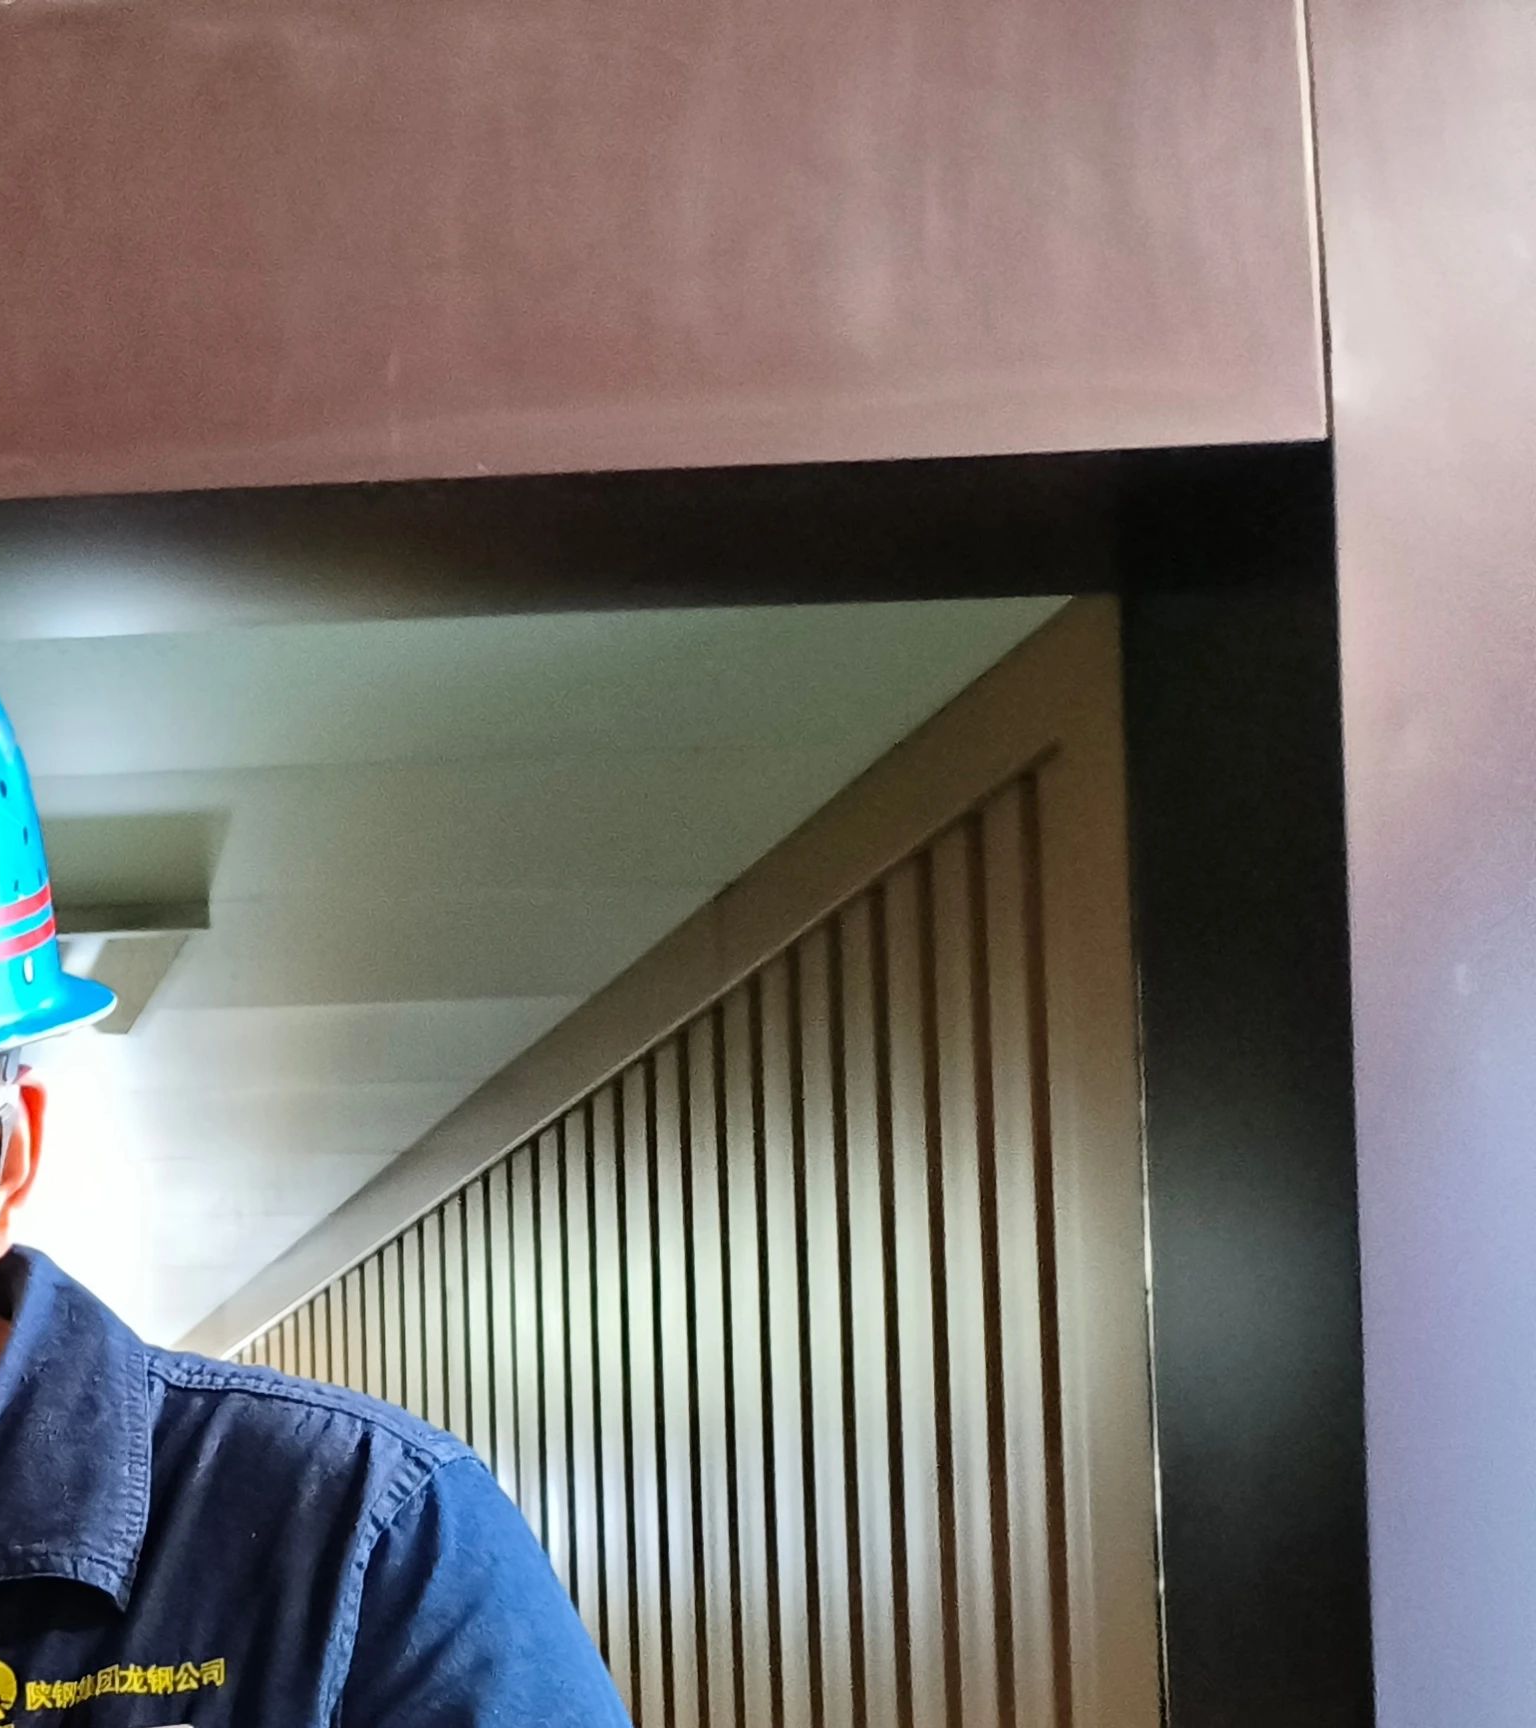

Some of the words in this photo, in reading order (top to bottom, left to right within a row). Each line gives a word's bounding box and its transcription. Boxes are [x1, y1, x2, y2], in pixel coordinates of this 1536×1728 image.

[25, 1657, 225, 1711] 陕钢集团龙钢公司
